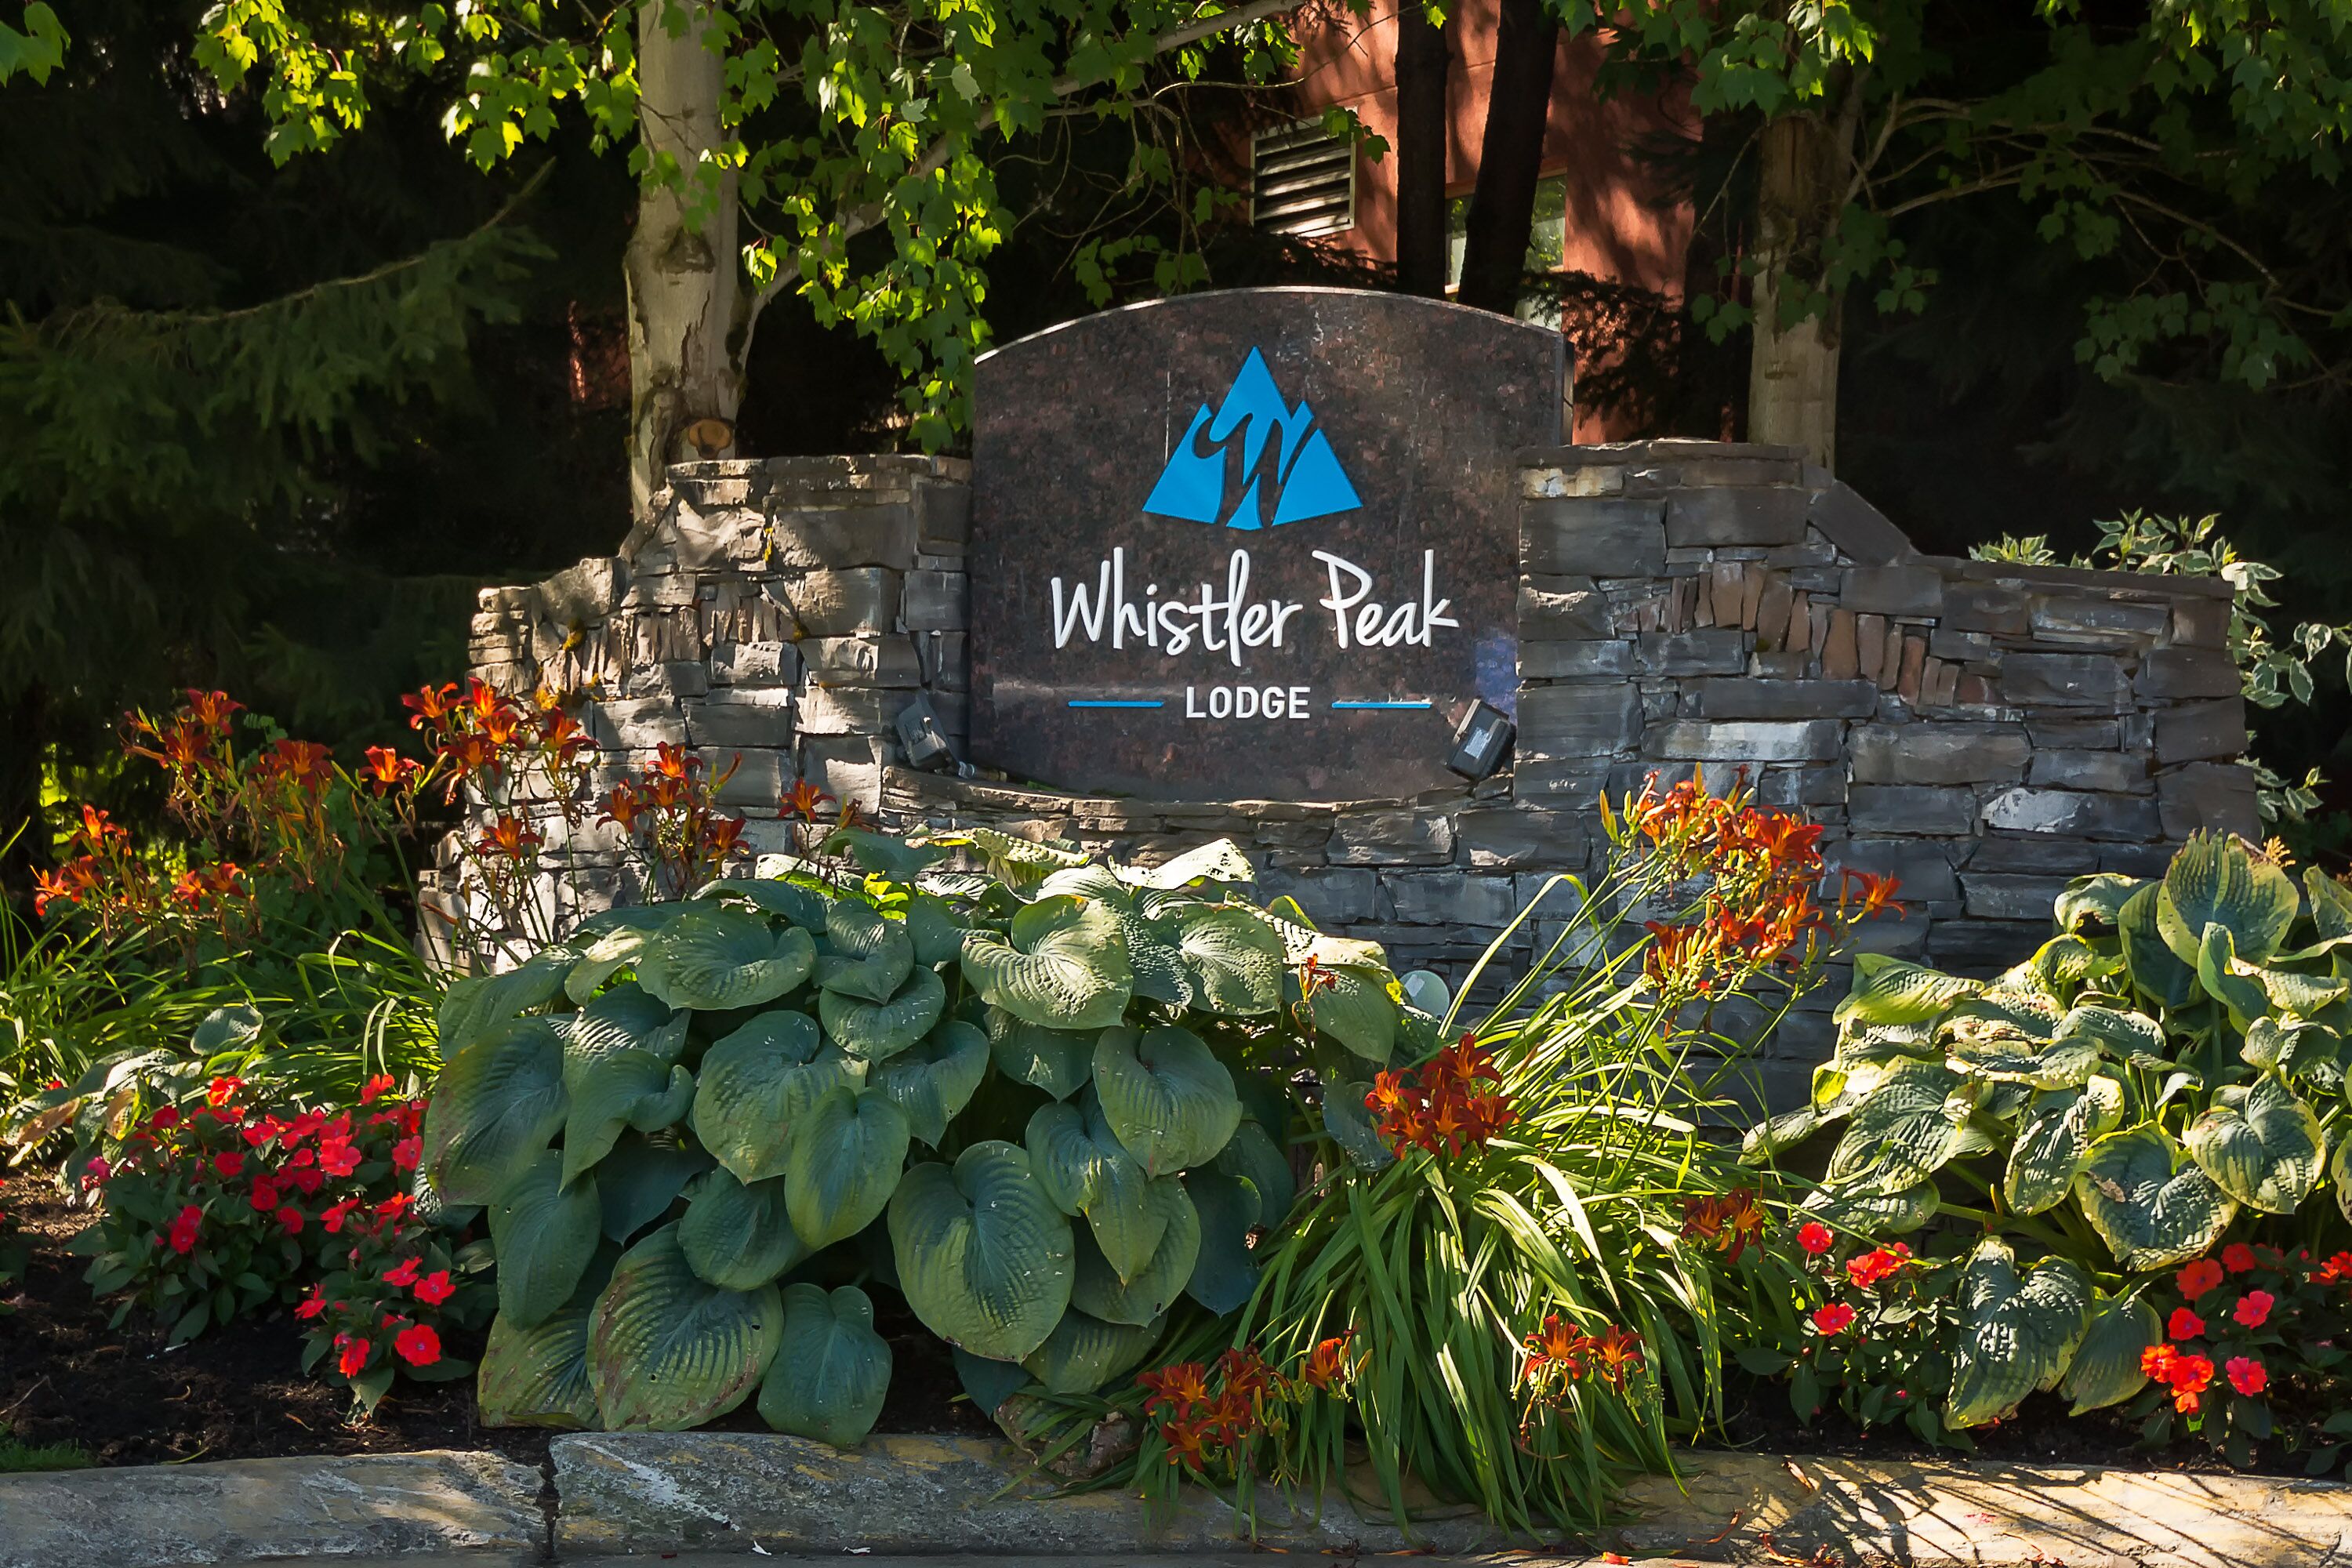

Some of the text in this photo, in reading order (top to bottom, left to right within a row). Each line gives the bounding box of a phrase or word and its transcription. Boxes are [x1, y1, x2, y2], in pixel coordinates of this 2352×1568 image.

[1051, 546, 1460, 668] Whistler Peak
[1185, 686, 1312, 720] LODGE
